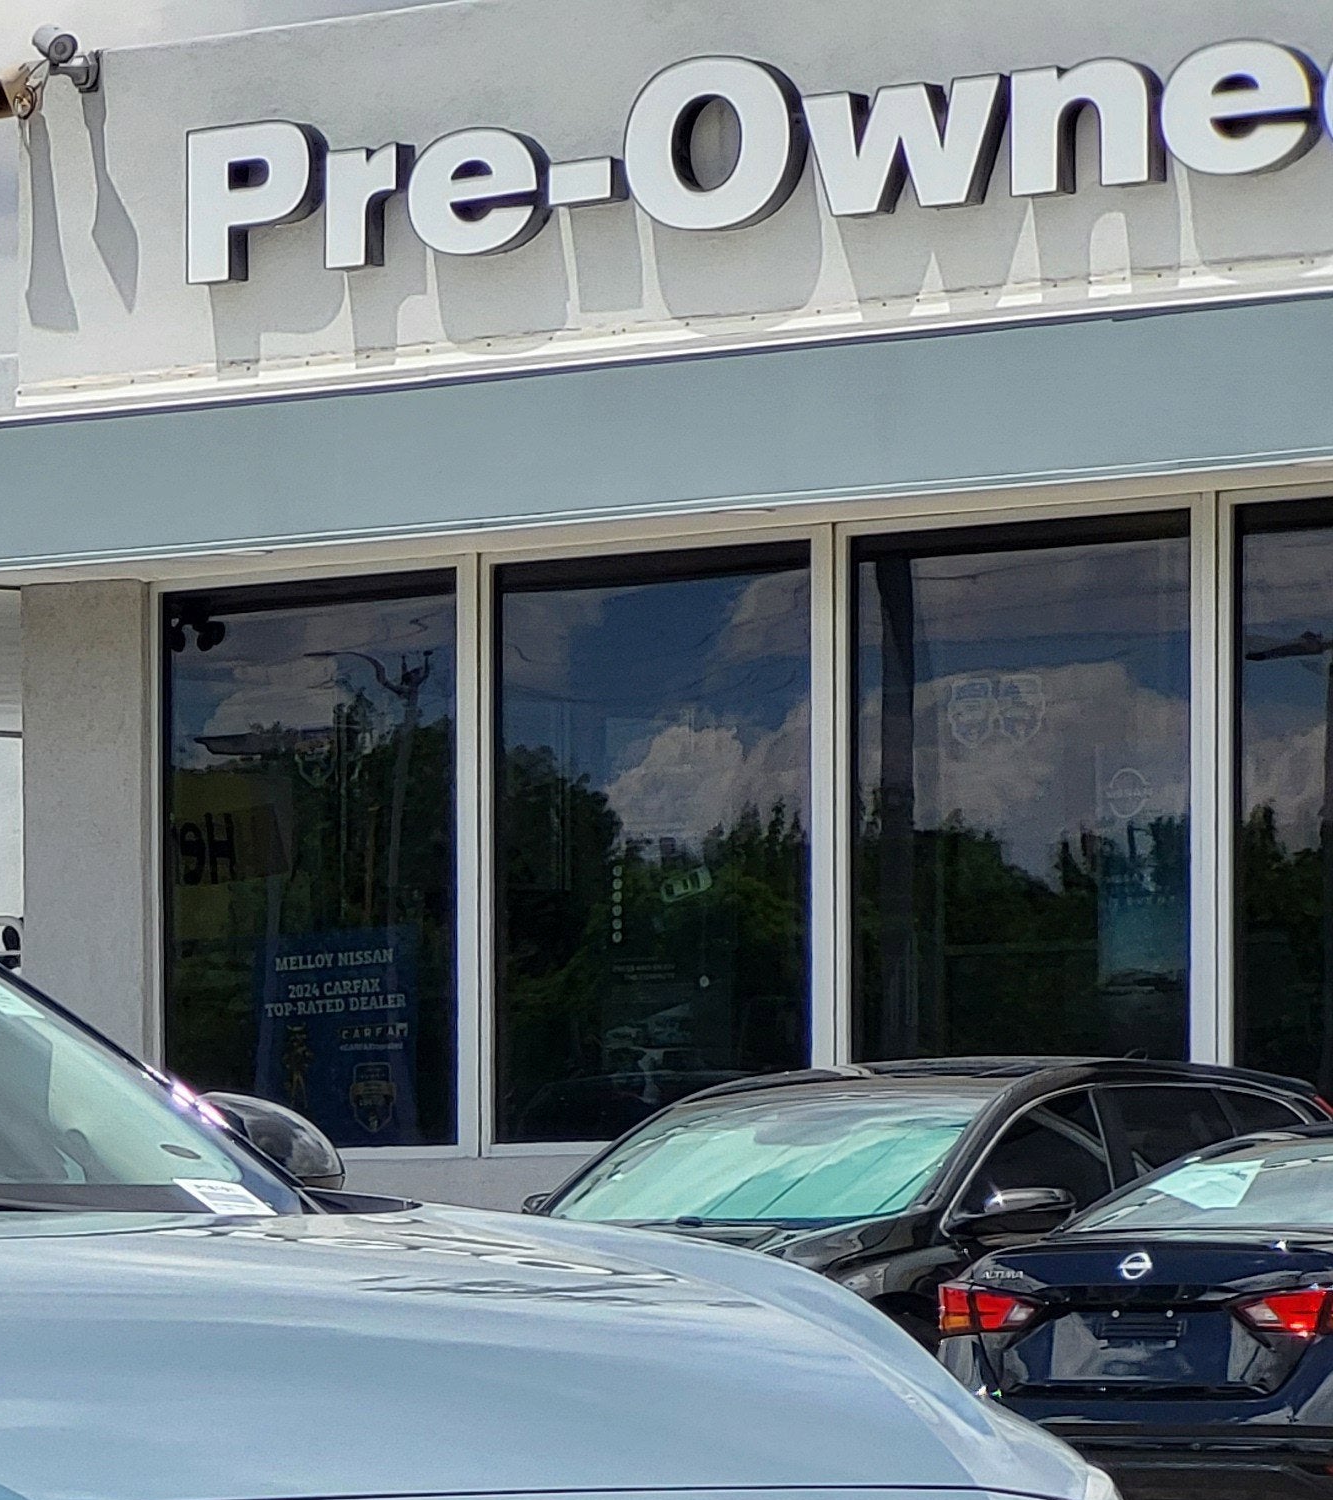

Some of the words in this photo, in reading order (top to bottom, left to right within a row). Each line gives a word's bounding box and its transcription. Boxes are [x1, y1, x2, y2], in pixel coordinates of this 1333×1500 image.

[186, 38, 1333, 285] Pre-Owne
[275, 953, 334, 972] MELLOY
[337, 948, 394, 967] NISSAN
[288, 983, 320, 999] 2024
[323, 978, 381, 996] CARFAX
[265, 998, 345, 1018] TOP-RATED
[349, 993, 406, 1012] DEALER
